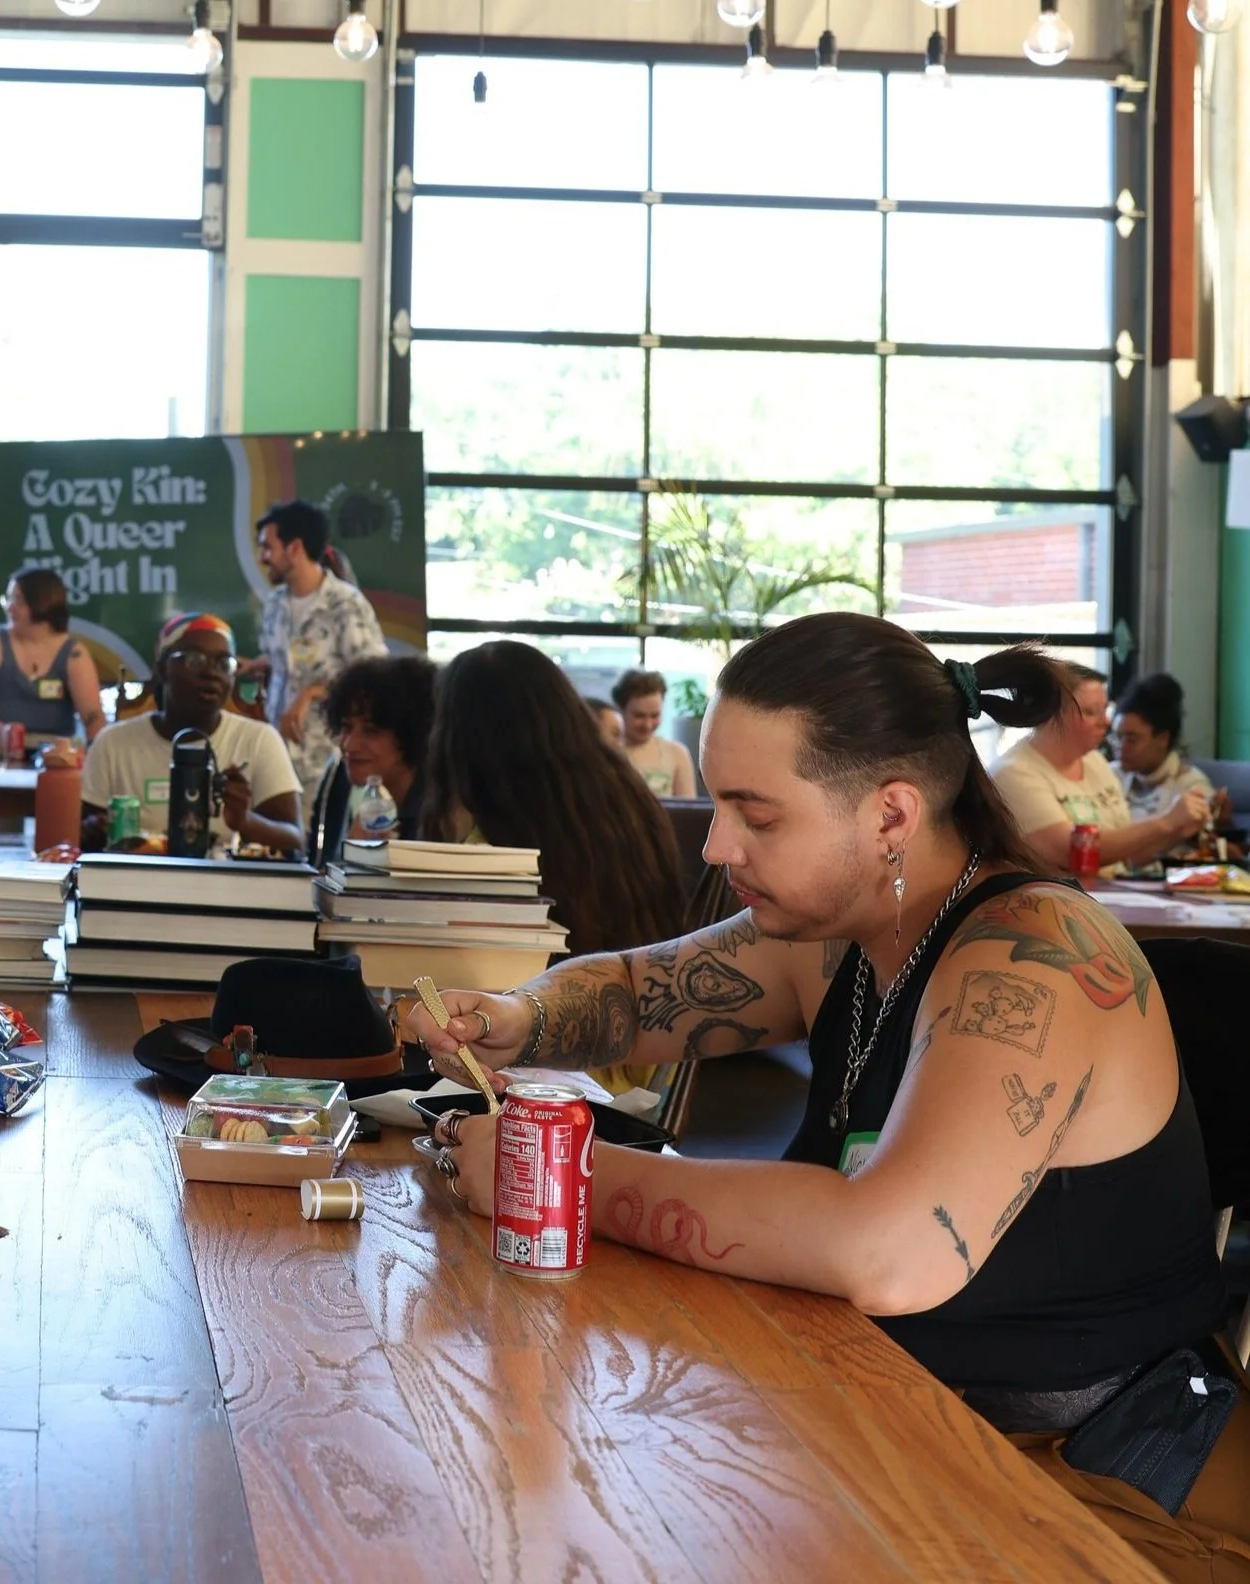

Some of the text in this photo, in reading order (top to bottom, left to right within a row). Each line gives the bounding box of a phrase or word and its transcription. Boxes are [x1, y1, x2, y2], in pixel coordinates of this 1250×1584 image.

[21, 465, 207, 516] Cozy Kin:
[23, 511, 187, 560] A Queer
[139, 555, 177, 593] In
[506, 1102, 530, 1119] Coke
[521, 1144, 536, 1155] 140
[578, 1184, 586, 1205] ME
[576, 1206, 585, 1266] RECYCLE
